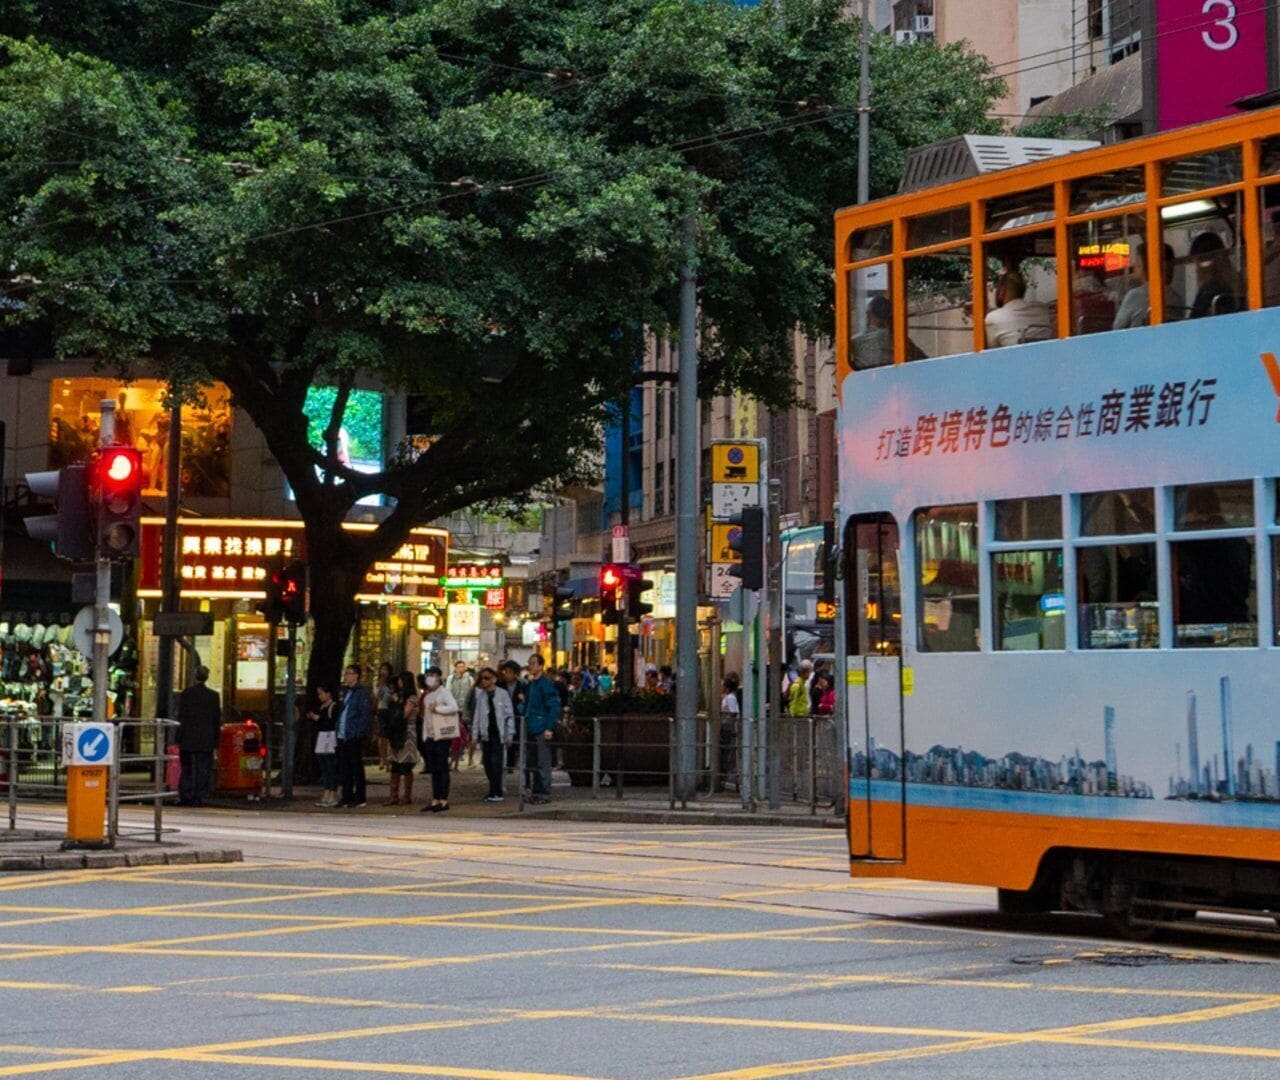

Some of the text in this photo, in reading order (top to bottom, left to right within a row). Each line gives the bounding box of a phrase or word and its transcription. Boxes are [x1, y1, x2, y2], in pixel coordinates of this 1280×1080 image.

[876, 378, 1217, 461] 打造跨境特色的綜合性商業銀行
